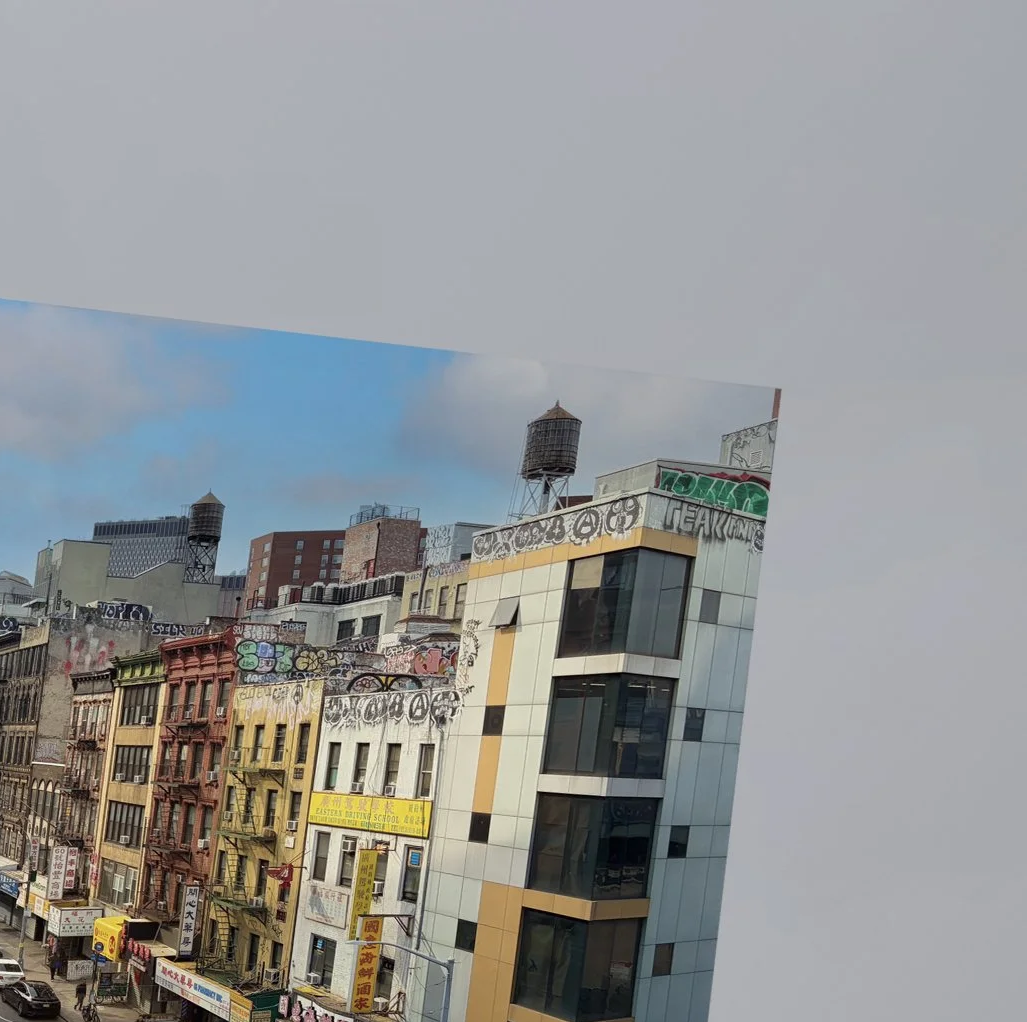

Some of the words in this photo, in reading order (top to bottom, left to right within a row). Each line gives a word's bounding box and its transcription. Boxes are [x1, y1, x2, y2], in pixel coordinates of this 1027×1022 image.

[316, 807, 342, 817] EASTERN
[345, 810, 371, 820] DRIVING
[373, 813, 399, 824] SCHOOL
